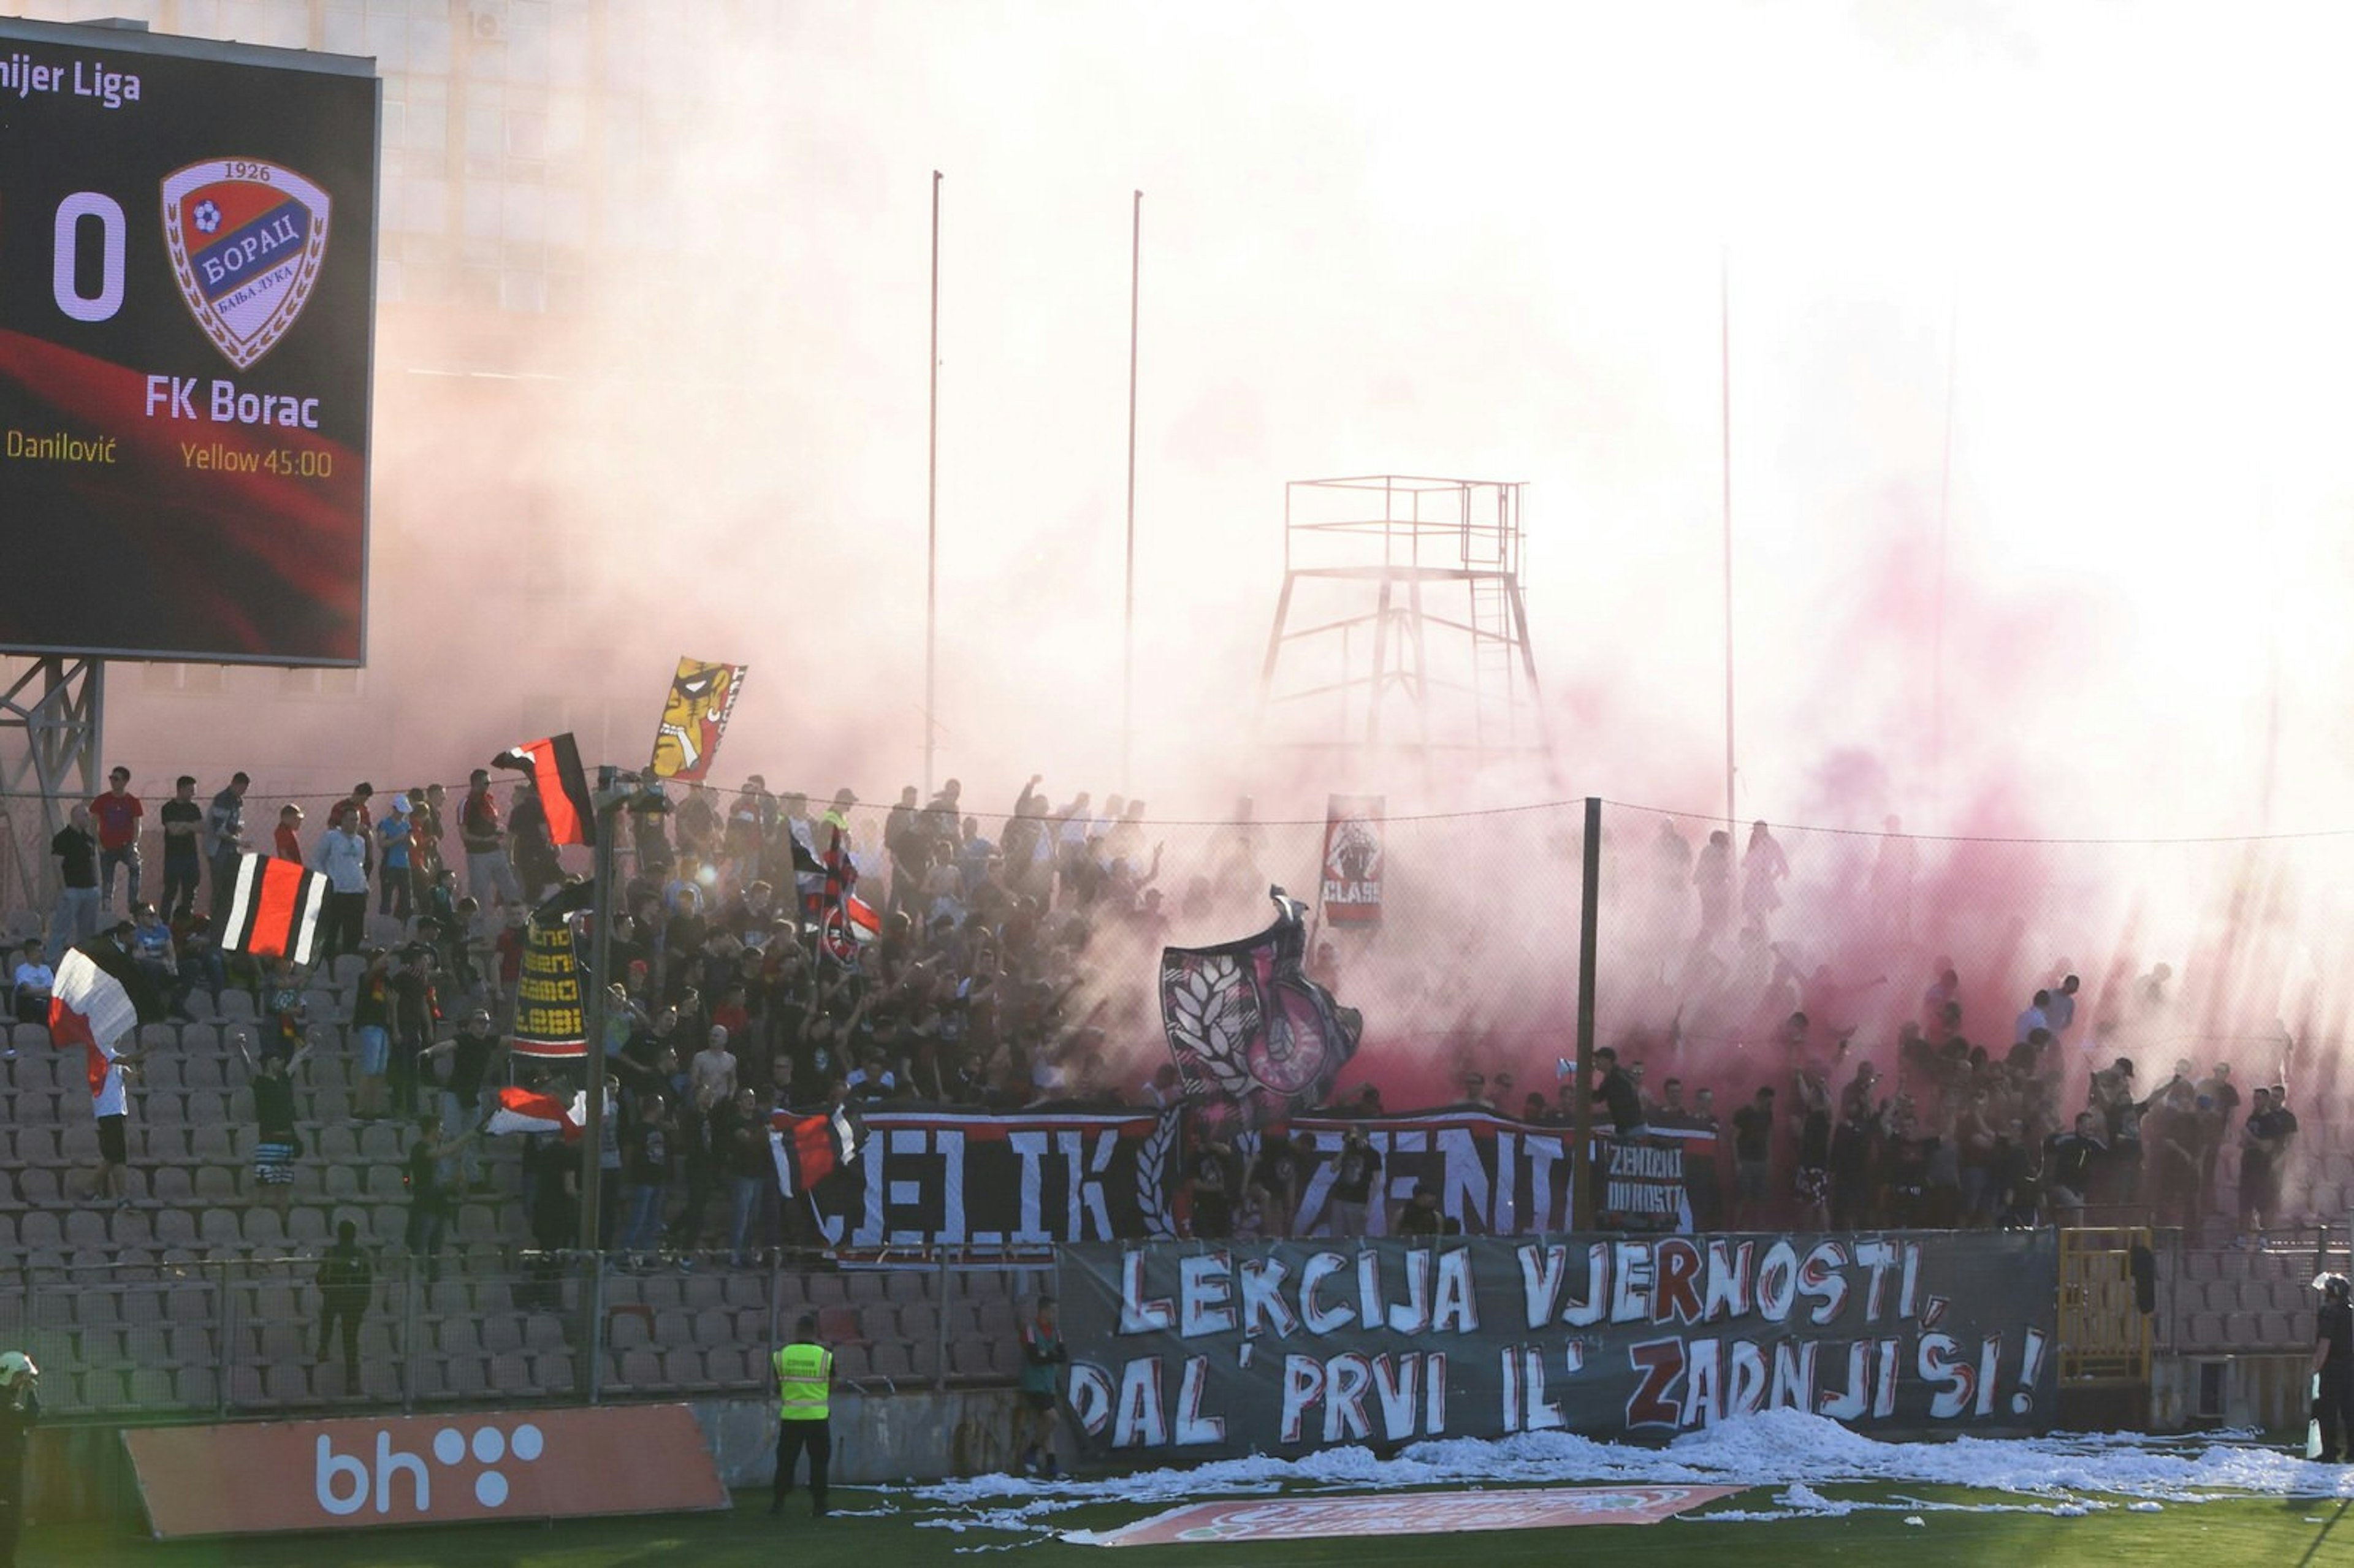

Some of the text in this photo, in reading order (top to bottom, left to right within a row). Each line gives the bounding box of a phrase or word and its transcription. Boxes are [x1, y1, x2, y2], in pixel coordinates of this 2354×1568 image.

[74, 61, 140, 108] Liga
[224, 162, 270, 181] 1926
[53, 191, 126, 322] 0
[202, 215, 299, 286] БОРАЦ
[217, 266, 293, 314] БАЊА ЛУКА
[146, 374, 319, 428] FK Borac
[7, 430, 333, 478] Danilović Yellow 45:00
[825, 1129, 1116, 1254] ELIK
[1118, 1238, 1950, 1339] LEKCIJA VJERNOSTI,
[1281, 1351, 1447, 1443] PRVI
[1626, 1336, 1900, 1429] ZADNJI
[316, 1430, 430, 1515] bh
